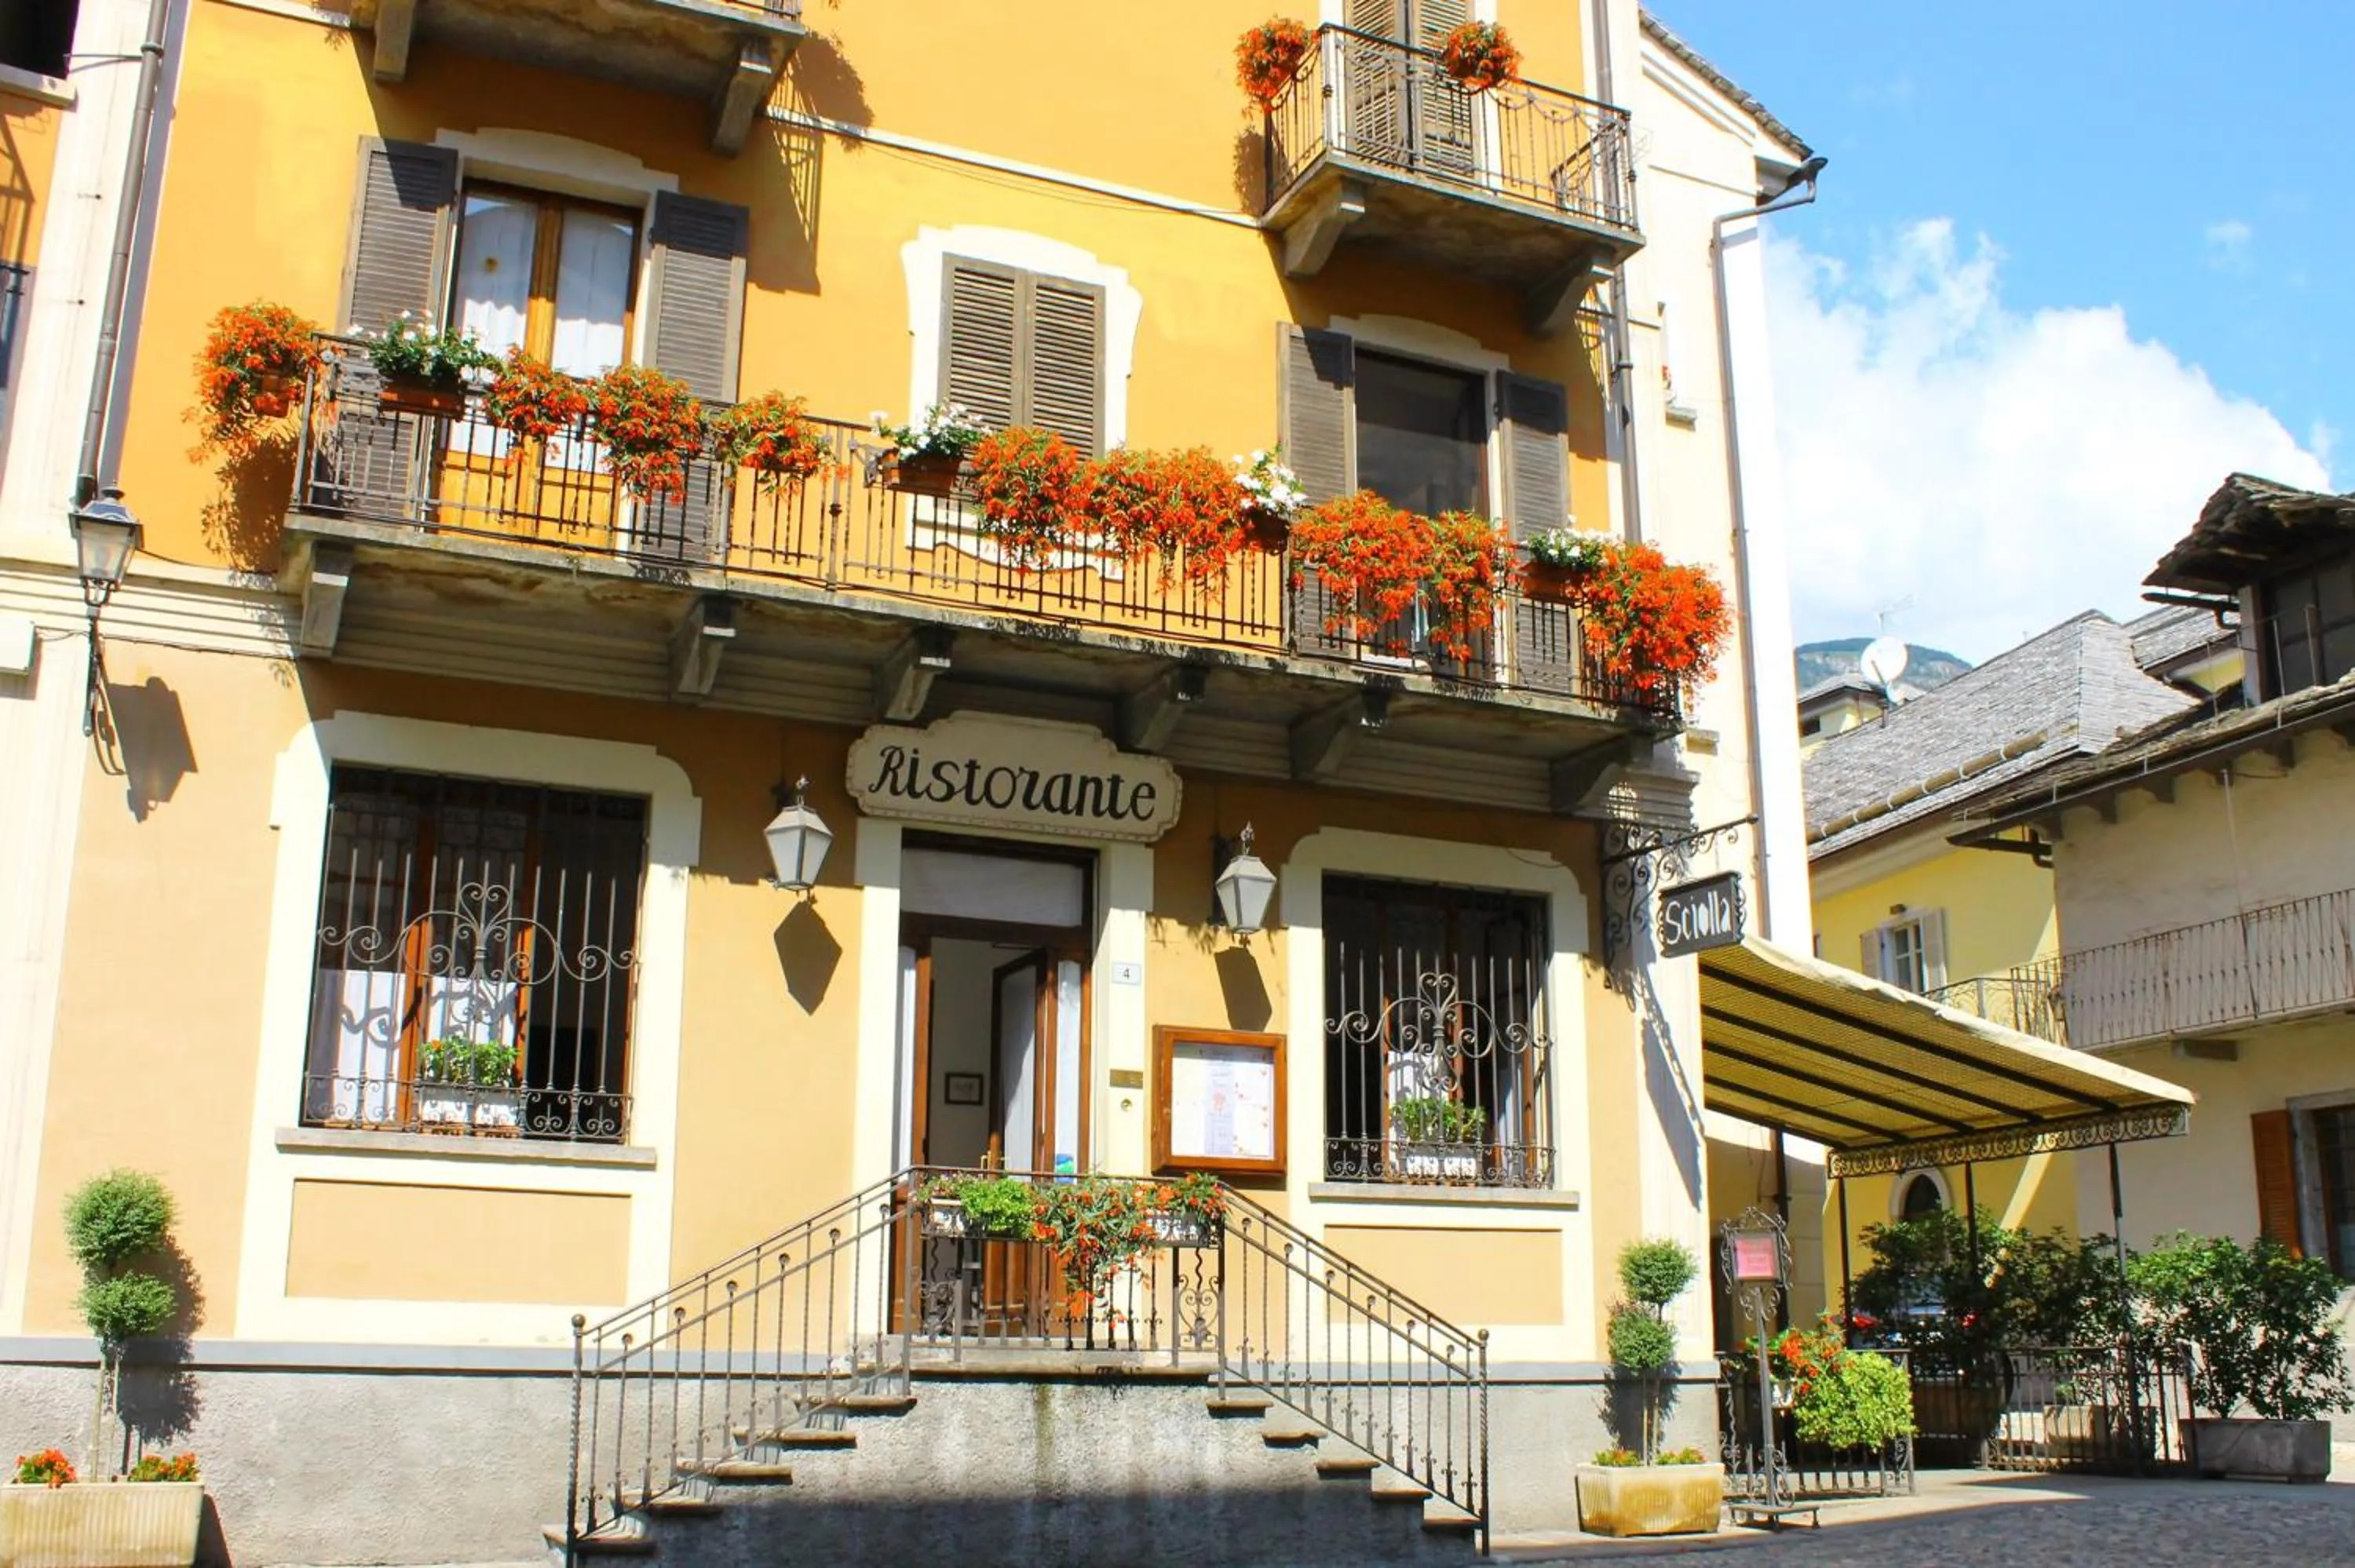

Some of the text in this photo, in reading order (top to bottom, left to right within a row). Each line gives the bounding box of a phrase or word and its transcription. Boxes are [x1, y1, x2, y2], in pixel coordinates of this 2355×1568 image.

[868, 745, 1157, 822] Ristorante
[1665, 889, 1731, 945] Sciolla
[1123, 968, 1130, 980] 4
